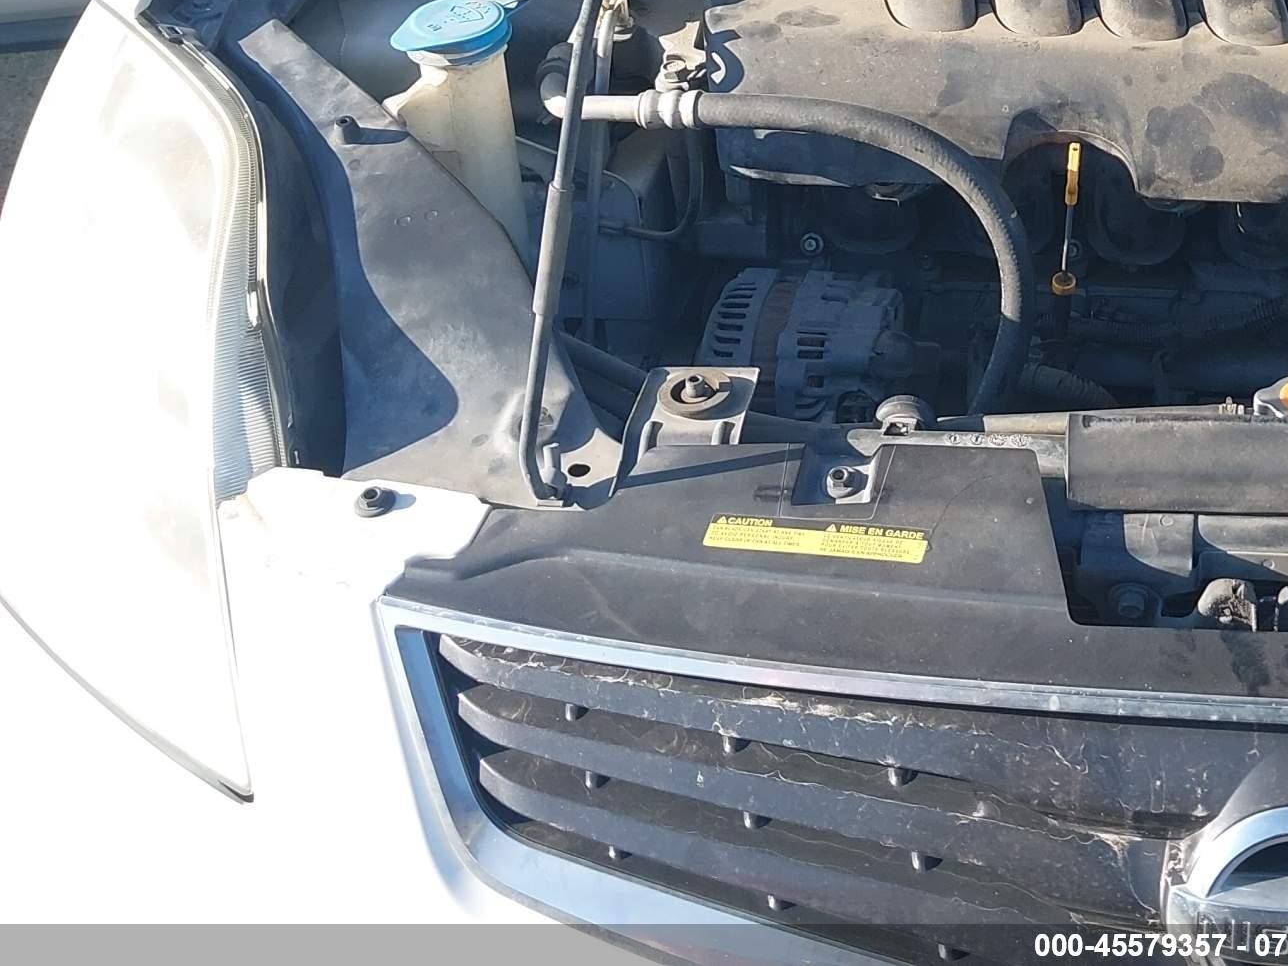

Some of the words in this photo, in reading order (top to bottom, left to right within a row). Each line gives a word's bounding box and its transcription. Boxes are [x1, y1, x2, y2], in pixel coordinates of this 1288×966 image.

[727, 517, 773, 526] CAUTION
[840, 524, 866, 535] MISE
[868, 527, 884, 536] EN
[885, 529, 925, 540] GARDE
